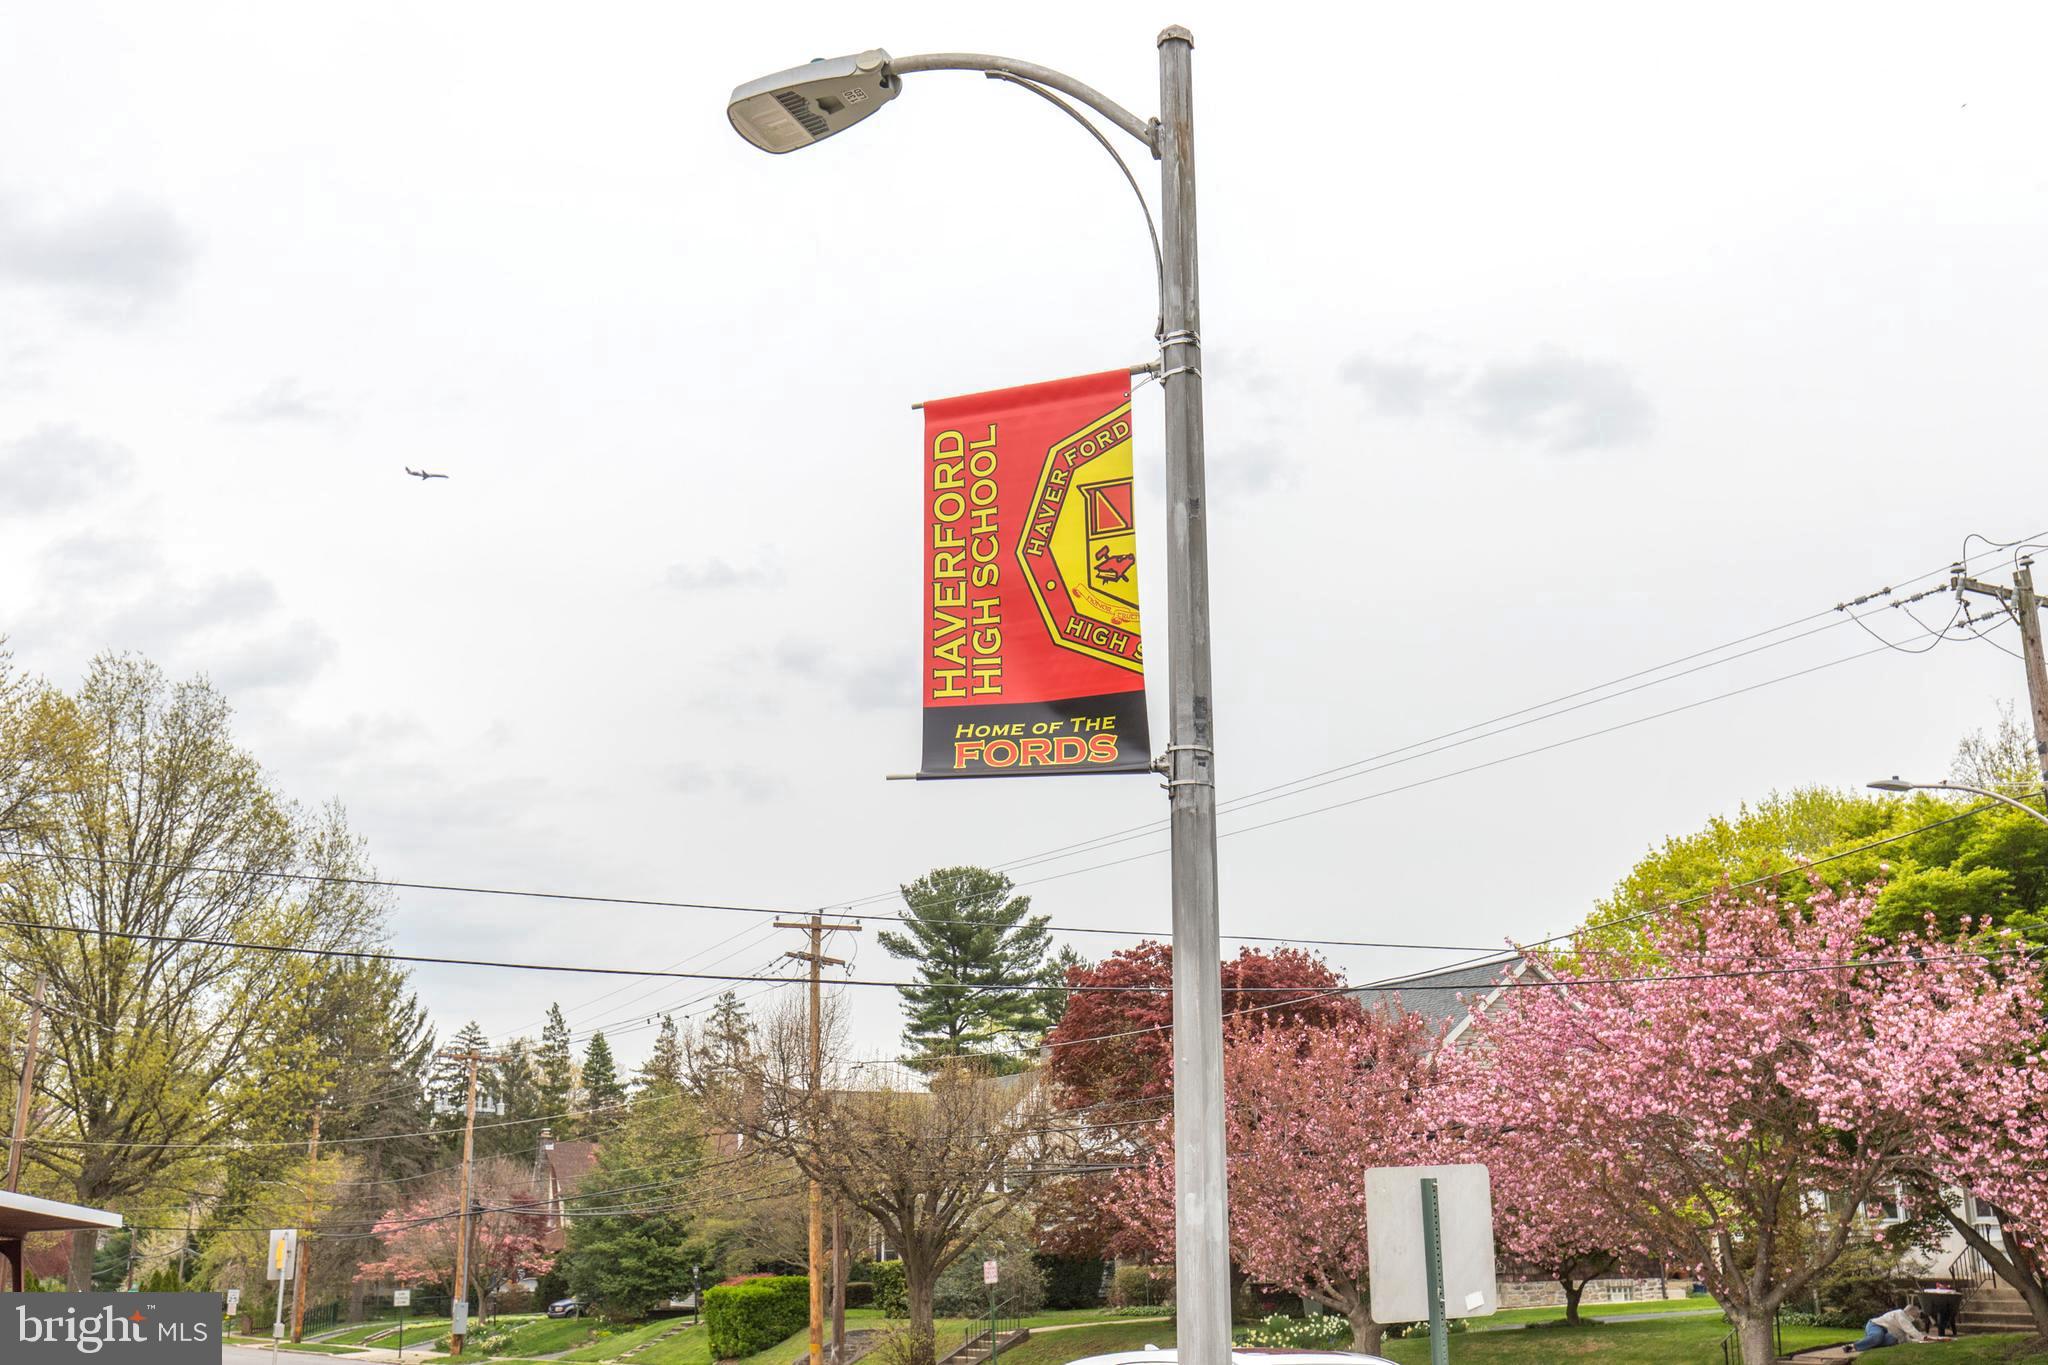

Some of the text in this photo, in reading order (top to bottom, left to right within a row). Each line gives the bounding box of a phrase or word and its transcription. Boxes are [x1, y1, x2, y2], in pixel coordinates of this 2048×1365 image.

[853, 88, 867, 100] LED
[1026, 420, 1130, 557] HAVER FORD
[932, 429, 967, 700] HAVERFORD
[968, 424, 1002, 696] HIGH SCHOOL
[1064, 616, 1129, 655] HIGH
[953, 733, 1118, 769] FORDS
